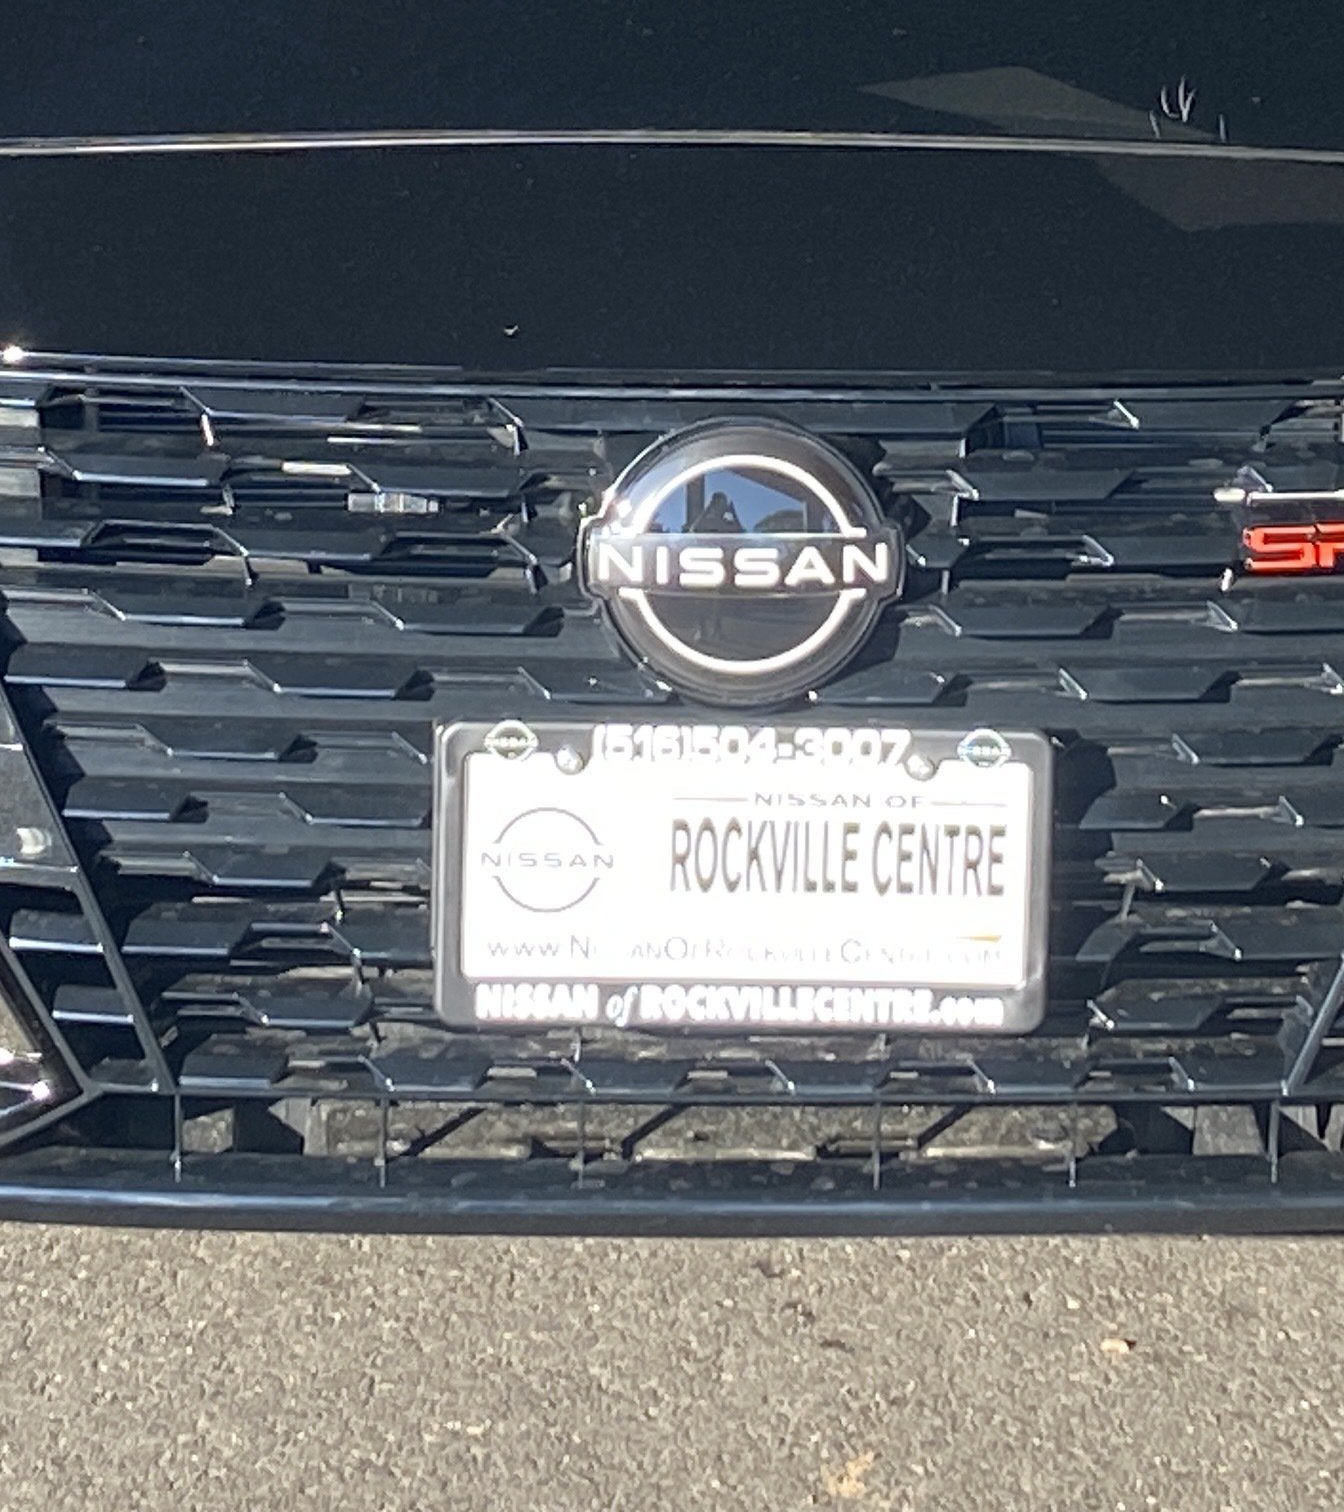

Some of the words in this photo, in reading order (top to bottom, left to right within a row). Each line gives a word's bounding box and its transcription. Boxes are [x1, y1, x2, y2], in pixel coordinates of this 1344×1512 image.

[596, 542, 888, 586] NISSAN
[755, 792, 871, 808] NISSAN
[885, 795, 925, 808] OF
[480, 852, 614, 868] NISSAN
[671, 817, 861, 894] ROCKVILLE
[873, 820, 1007, 897] CENTRE
[475, 983, 599, 1019] NISSAN
[605, 985, 639, 1027] of
